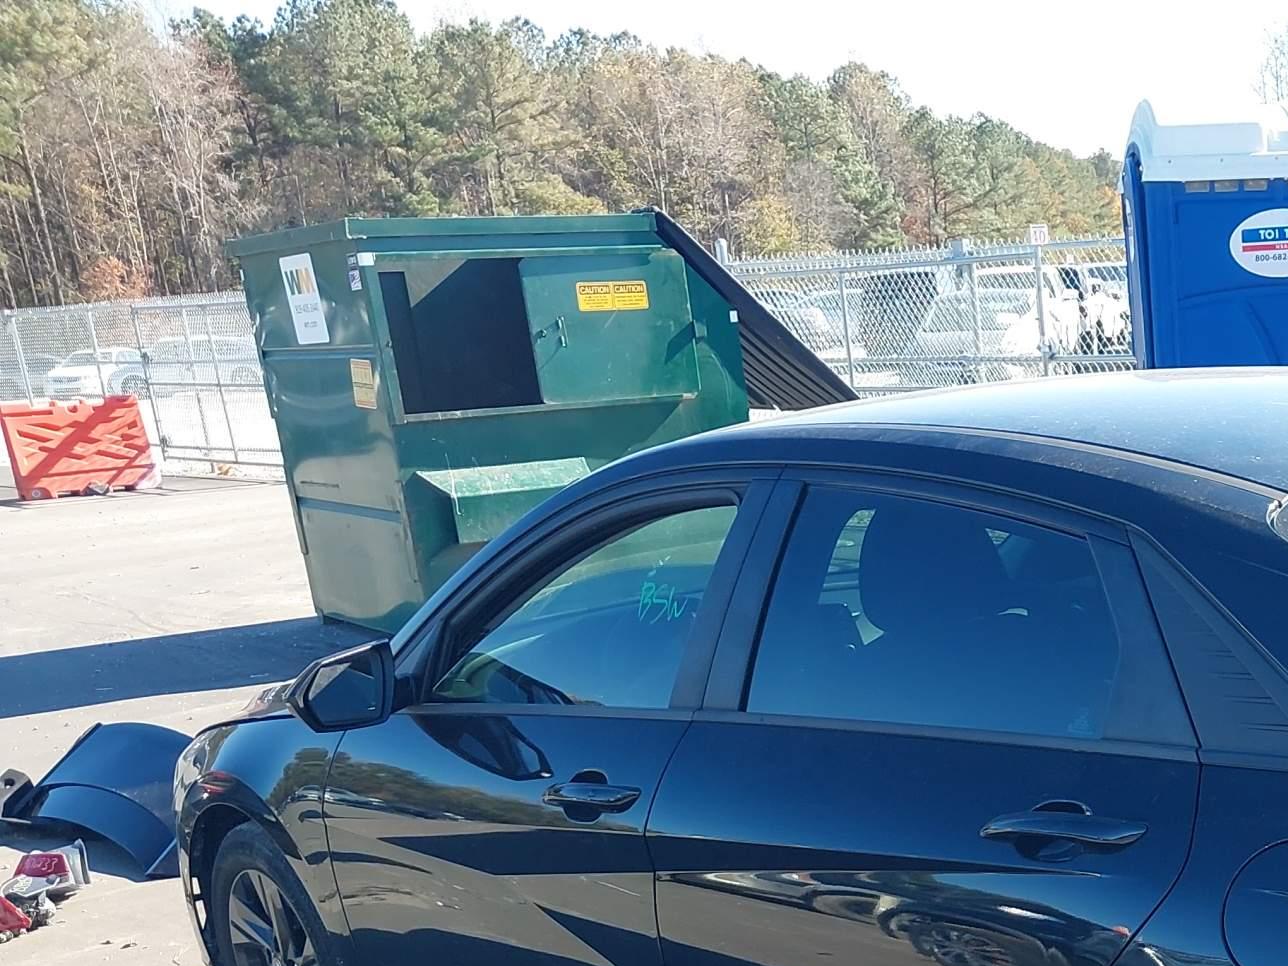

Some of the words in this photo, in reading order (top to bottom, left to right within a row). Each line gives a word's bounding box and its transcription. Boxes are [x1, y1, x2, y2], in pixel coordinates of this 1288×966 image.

[1258, 228, 1279, 240] TOI
[284, 266, 315, 295] WM
[580, 286, 610, 294] CAUTION
[614, 284, 644, 293] CAUTION
